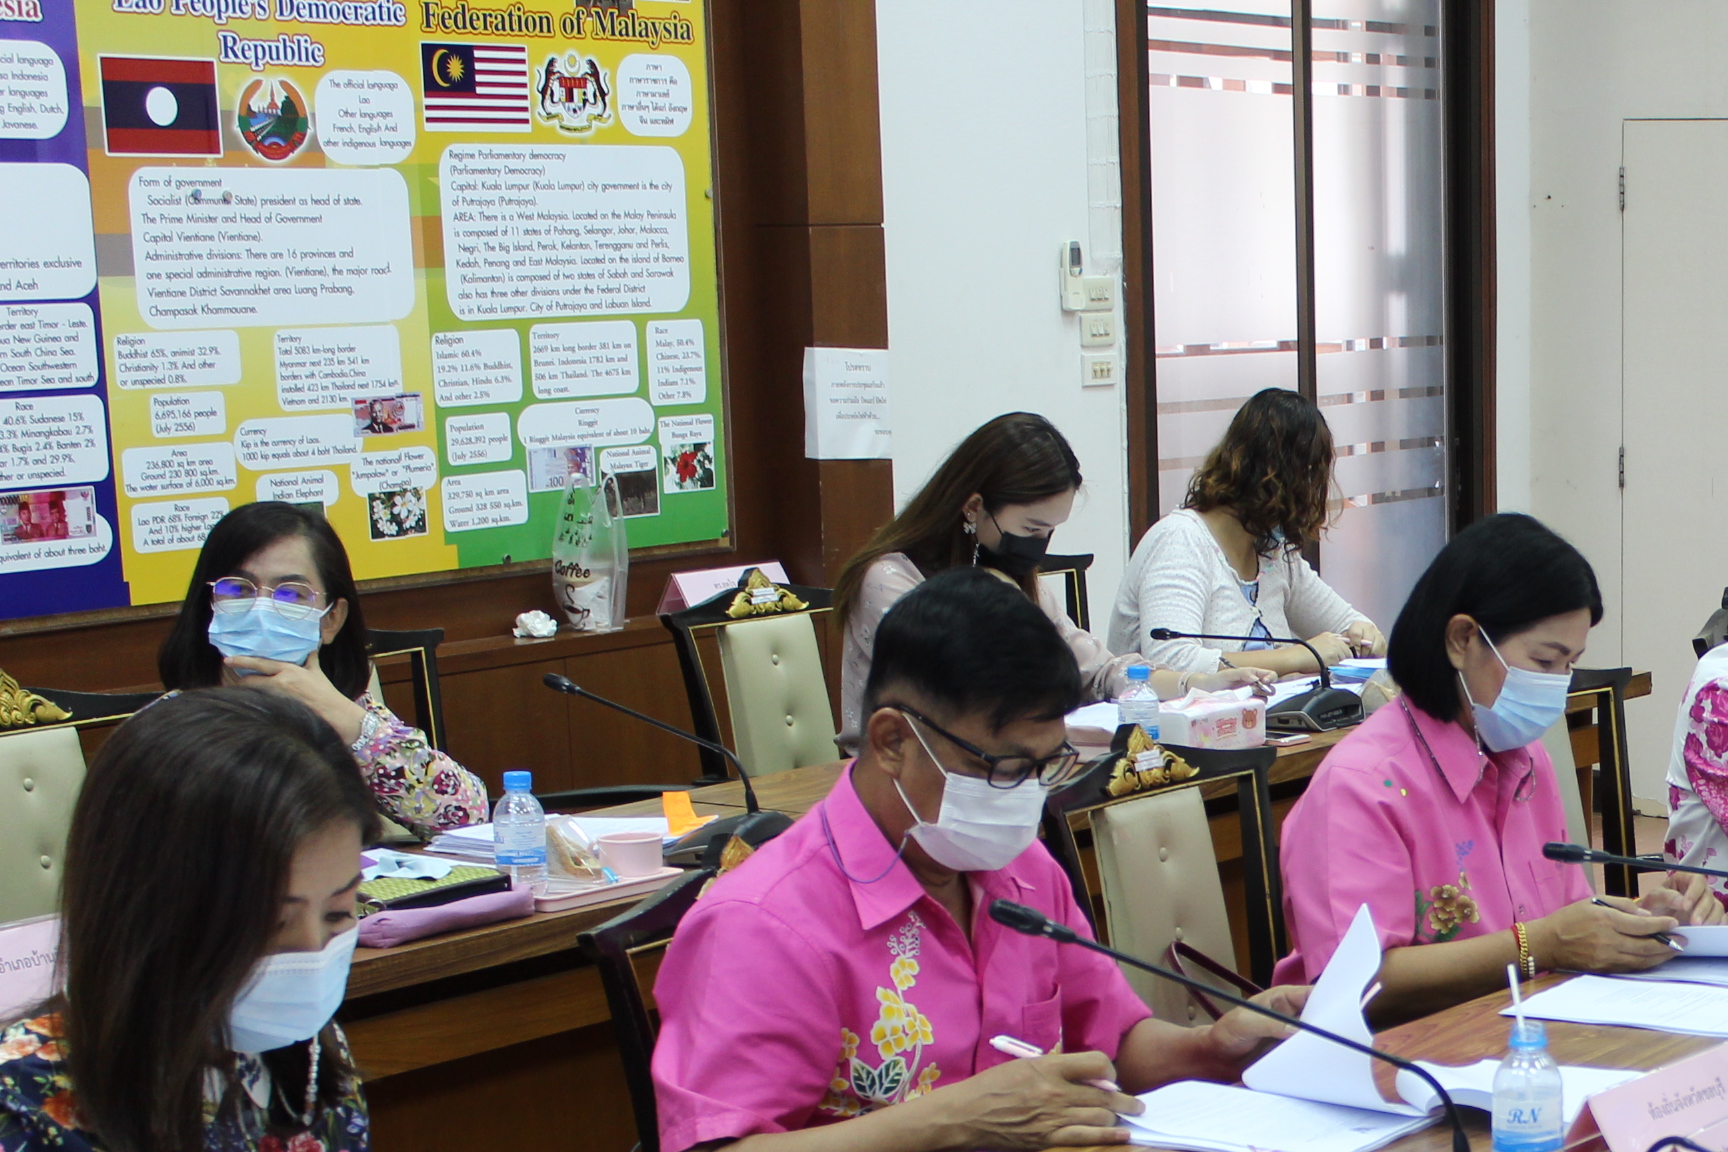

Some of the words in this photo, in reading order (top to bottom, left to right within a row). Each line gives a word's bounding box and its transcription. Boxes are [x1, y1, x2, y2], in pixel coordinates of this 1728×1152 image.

[277, 0, 405, 23] Democratic
[423, 2, 551, 33] Federation
[563, 12, 584, 36] of
[594, 11, 692, 45] Malaysia
[220, 34, 324, 67] Republic
[11, 71, 48, 81] Indonesia
[329, 79, 341, 88] The
[343, 79, 364, 89] official
[8, 86, 48, 101] languages
[359, 95, 370, 104] Lao
[338, 109, 357, 118] Other
[359, 123, 382, 136] English
[384, 123, 398, 132] And
[323, 139, 339, 147] other
[342, 139, 376, 151] indigenous
[380, 138, 412, 150] languages
[449, 151, 475, 162] Regime
[479, 151, 526, 162] Parliamentary
[529, 150, 566, 162] democracy
[450, 165, 501, 177] (Parliamentary
[504, 165, 546, 177] Democracy)
[139, 176, 160, 187] Form
[164, 176, 172, 187] of
[175, 178, 222, 189] government
[482, 181, 502, 190] Kuala
[505, 181, 529, 192] Lumpur
[533, 180, 555, 191] (Kuala
[558, 180, 585, 192] Lumpur)
[588, 181, 599, 192] city
[601, 181, 639, 192] government
[649, 180, 659, 190] the
[662, 180, 672, 191] city
[148, 195, 181, 206] Socialist
[235, 195, 257, 206] State)
[261, 196, 296, 208] president
[299, 197, 308, 206] as
[310, 195, 330, 206] head
[333, 195, 341, 206] of
[344, 197, 362, 206] state.
[452, 196, 459, 206] of
[462, 196, 495, 208] Putrajaya
[142, 213, 156, 224] The
[160, 213, 183, 224] Prime
[187, 213, 217, 224] Minister
[221, 213, 236, 224] and
[240, 213, 261, 223] Head
[264, 213, 272, 223] of
[276, 213, 322, 224] Government
[143, 231, 173, 244] Capital
[177, 231, 215, 242] Vientiane
[145, 250, 203, 261] Administrative
[207, 248, 243, 260] divisions:
[245, 249, 267, 259] There
[270, 251, 283, 259] are
[287, 249, 297, 259] 16
[300, 249, 336, 261] provinces
[339, 247, 354, 258] and
[44, 256, 82, 268] exclusive
[146, 271, 162, 280] one
[165, 268, 194, 282] special
[197, 267, 252, 278] administrative
[255, 267, 282, 280] region.
[332, 266, 344, 277] the
[347, 267, 368, 278] major
[15, 278, 38, 290] Aceh
[148, 287, 186, 298] Vientiane
[190, 287, 217, 297] District
[220, 284, 270, 296] Savannakhet
[294, 285, 317, 298] Luang
[7, 307, 38, 317] Territory
[149, 304, 197, 318] Champasak
[13, 336, 31, 344] New
[34, 334, 61, 343] Guinea
[64, 332, 79, 342] and
[117, 337, 145, 347] Religion
[435, 336, 464, 346] Religion
[12, 348, 31, 358] South
[35, 348, 57, 356] China
[437, 350, 459, 359] Islamic
[119, 362, 158, 374] Christianity
[162, 362, 178, 371] 1.3%
[181, 361, 196, 370] And
[199, 360, 216, 369] other
[153, 397, 190, 408] Population
[30, 413, 65, 424] Sudanese
[69, 412, 84, 422] 15%
[194, 409, 217, 420] people
[21, 427, 72, 440] Minangkabau
[75, 425, 93, 435] 2.7%
[156, 422, 172, 435] (July
[174, 422, 195, 433] 2556)
[450, 423, 484, 432] Population
[489, 435, 508, 445] people
[452, 452, 466, 461] (July
[469, 450, 487, 460] 2556)
[270, 477, 298, 487] National
[301, 476, 324, 485] Animal
[549, 476, 564, 487] 100
[273, 490, 294, 500] Indian
[296, 489, 324, 499] Elephant
[555, 559, 590, 578] Coffee
